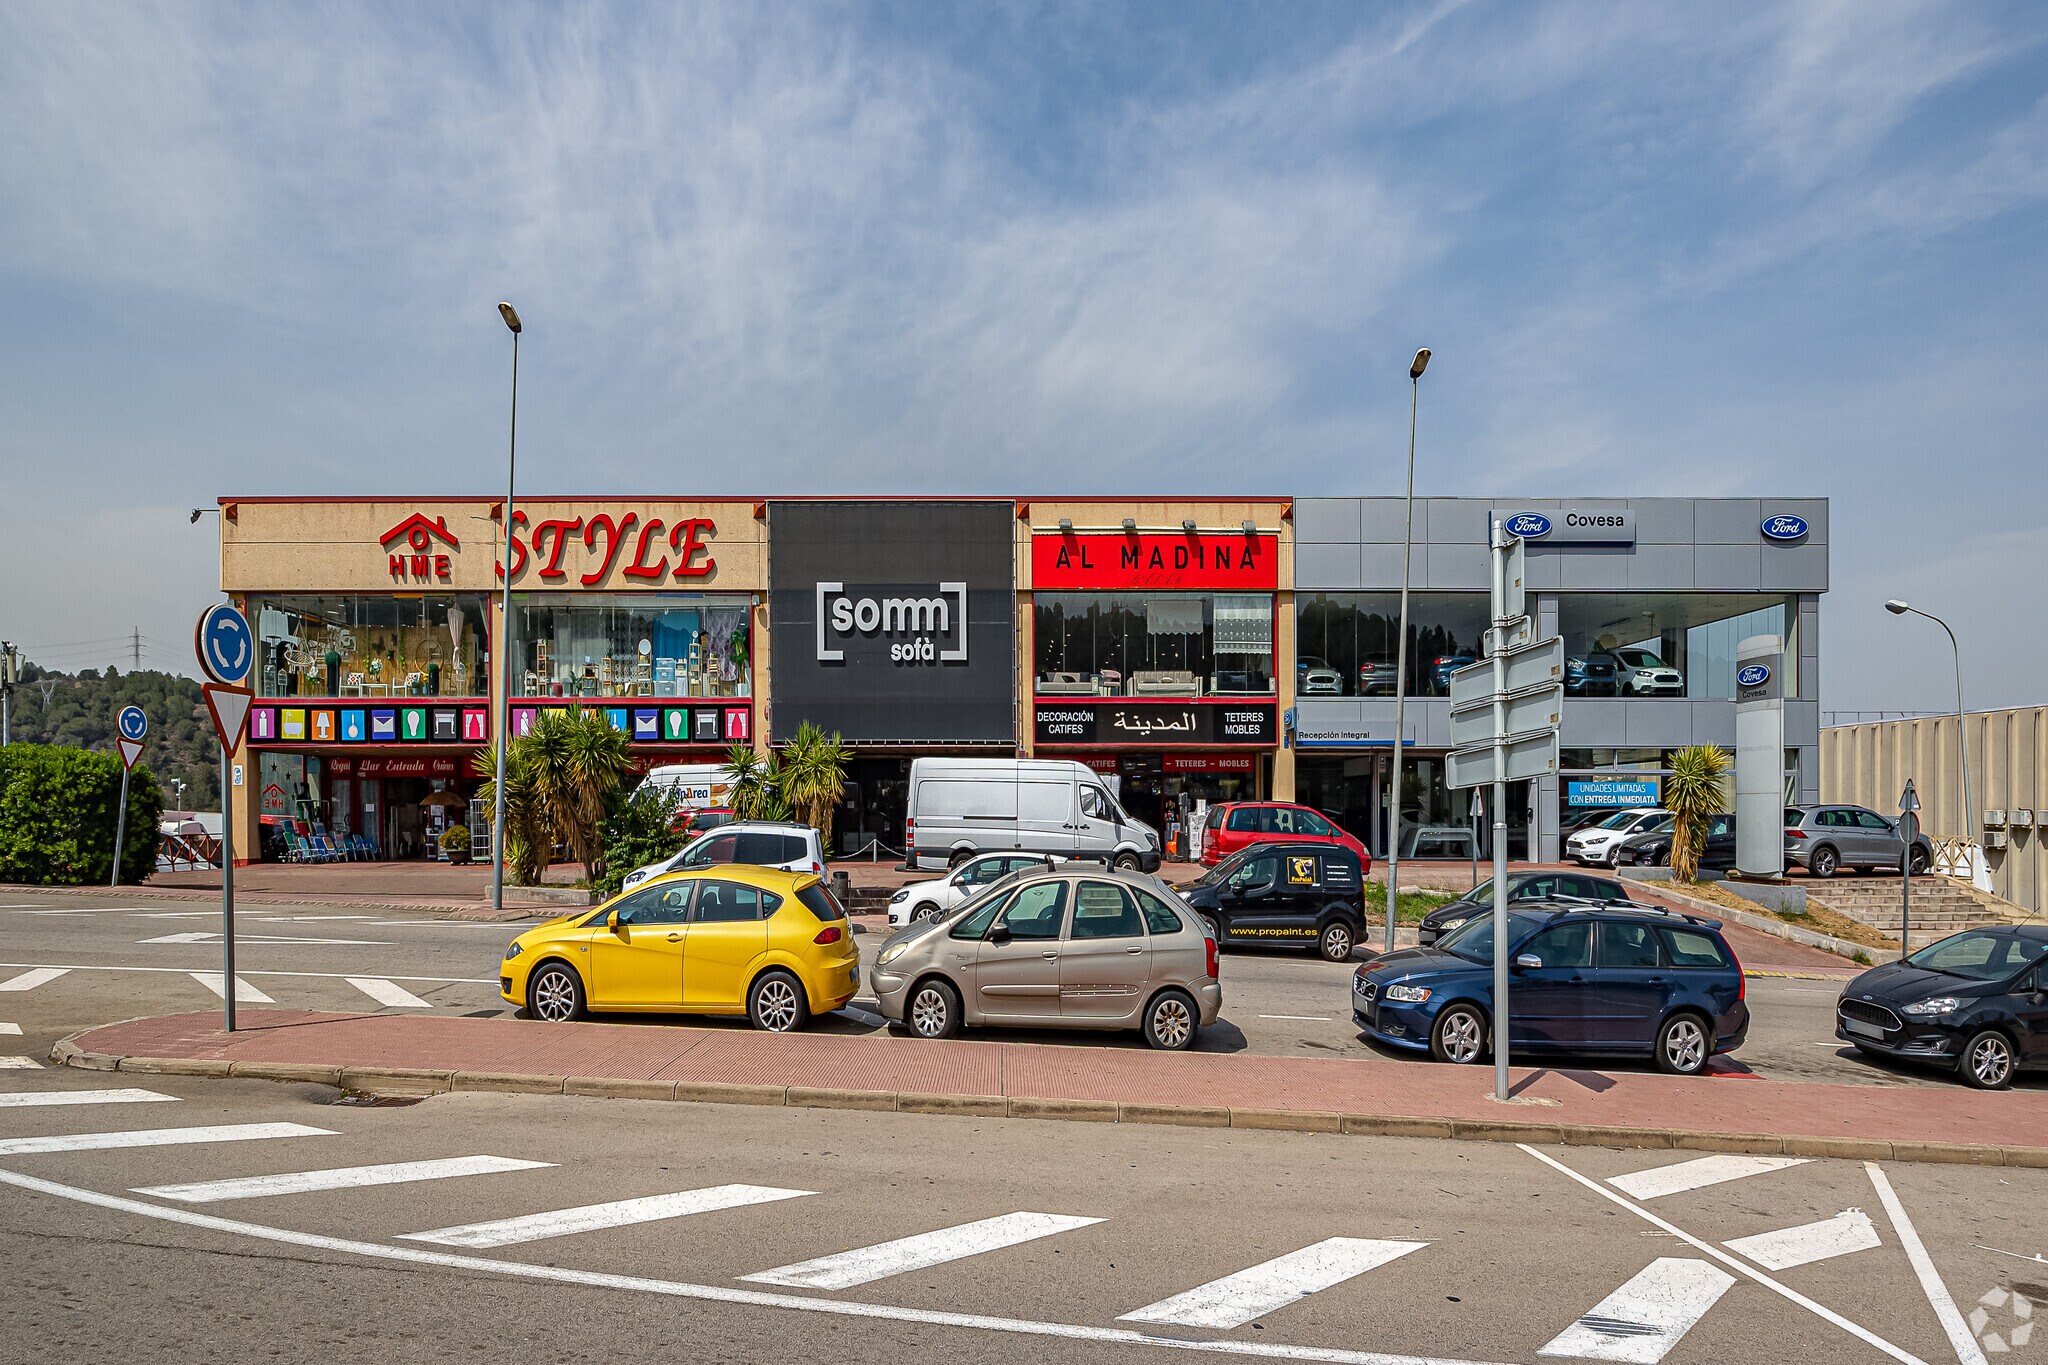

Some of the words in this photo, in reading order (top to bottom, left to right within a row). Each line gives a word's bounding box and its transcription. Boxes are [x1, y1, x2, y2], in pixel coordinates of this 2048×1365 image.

[1514, 516, 1543, 533] Ford
[1566, 513, 1625, 527] Covesa
[1771, 517, 1800, 534] Ford
[495, 510, 715, 585] STYLE
[1056, 545, 1095, 569] AL
[1121, 545, 1256, 570] MADINA
[831, 597, 949, 632] somm
[890, 636, 935, 661] sofà
[1742, 667, 1762, 682] Ford
[1742, 689, 1767, 699] Covesa
[1037, 710, 1094, 723] DECORACIÓN
[1225, 712, 1264, 722] TETERES
[1113, 711, 1196, 736] المدينة
[1048, 724, 1084, 735] CATIFES
[1225, 724, 1261, 735] MOBLES
[1298, 731, 1340, 740] Recepción
[1341, 731, 1370, 740] Integral
[386, 759, 425, 771] Entrada
[1086, 760, 1116, 768] CATIFES
[1175, 759, 1207, 768] TETERES
[1219, 759, 1250, 768] MOBLES
[1580, 784, 1612, 793] UNIDADES
[1613, 784, 1646, 793] LIMITADAS
[1569, 795, 1584, 804] CON
[1584, 795, 1617, 804] ENTREGA
[1617, 795, 1656, 804] INMEDIATA
[1230, 928, 1318, 937] www.propaint.es
